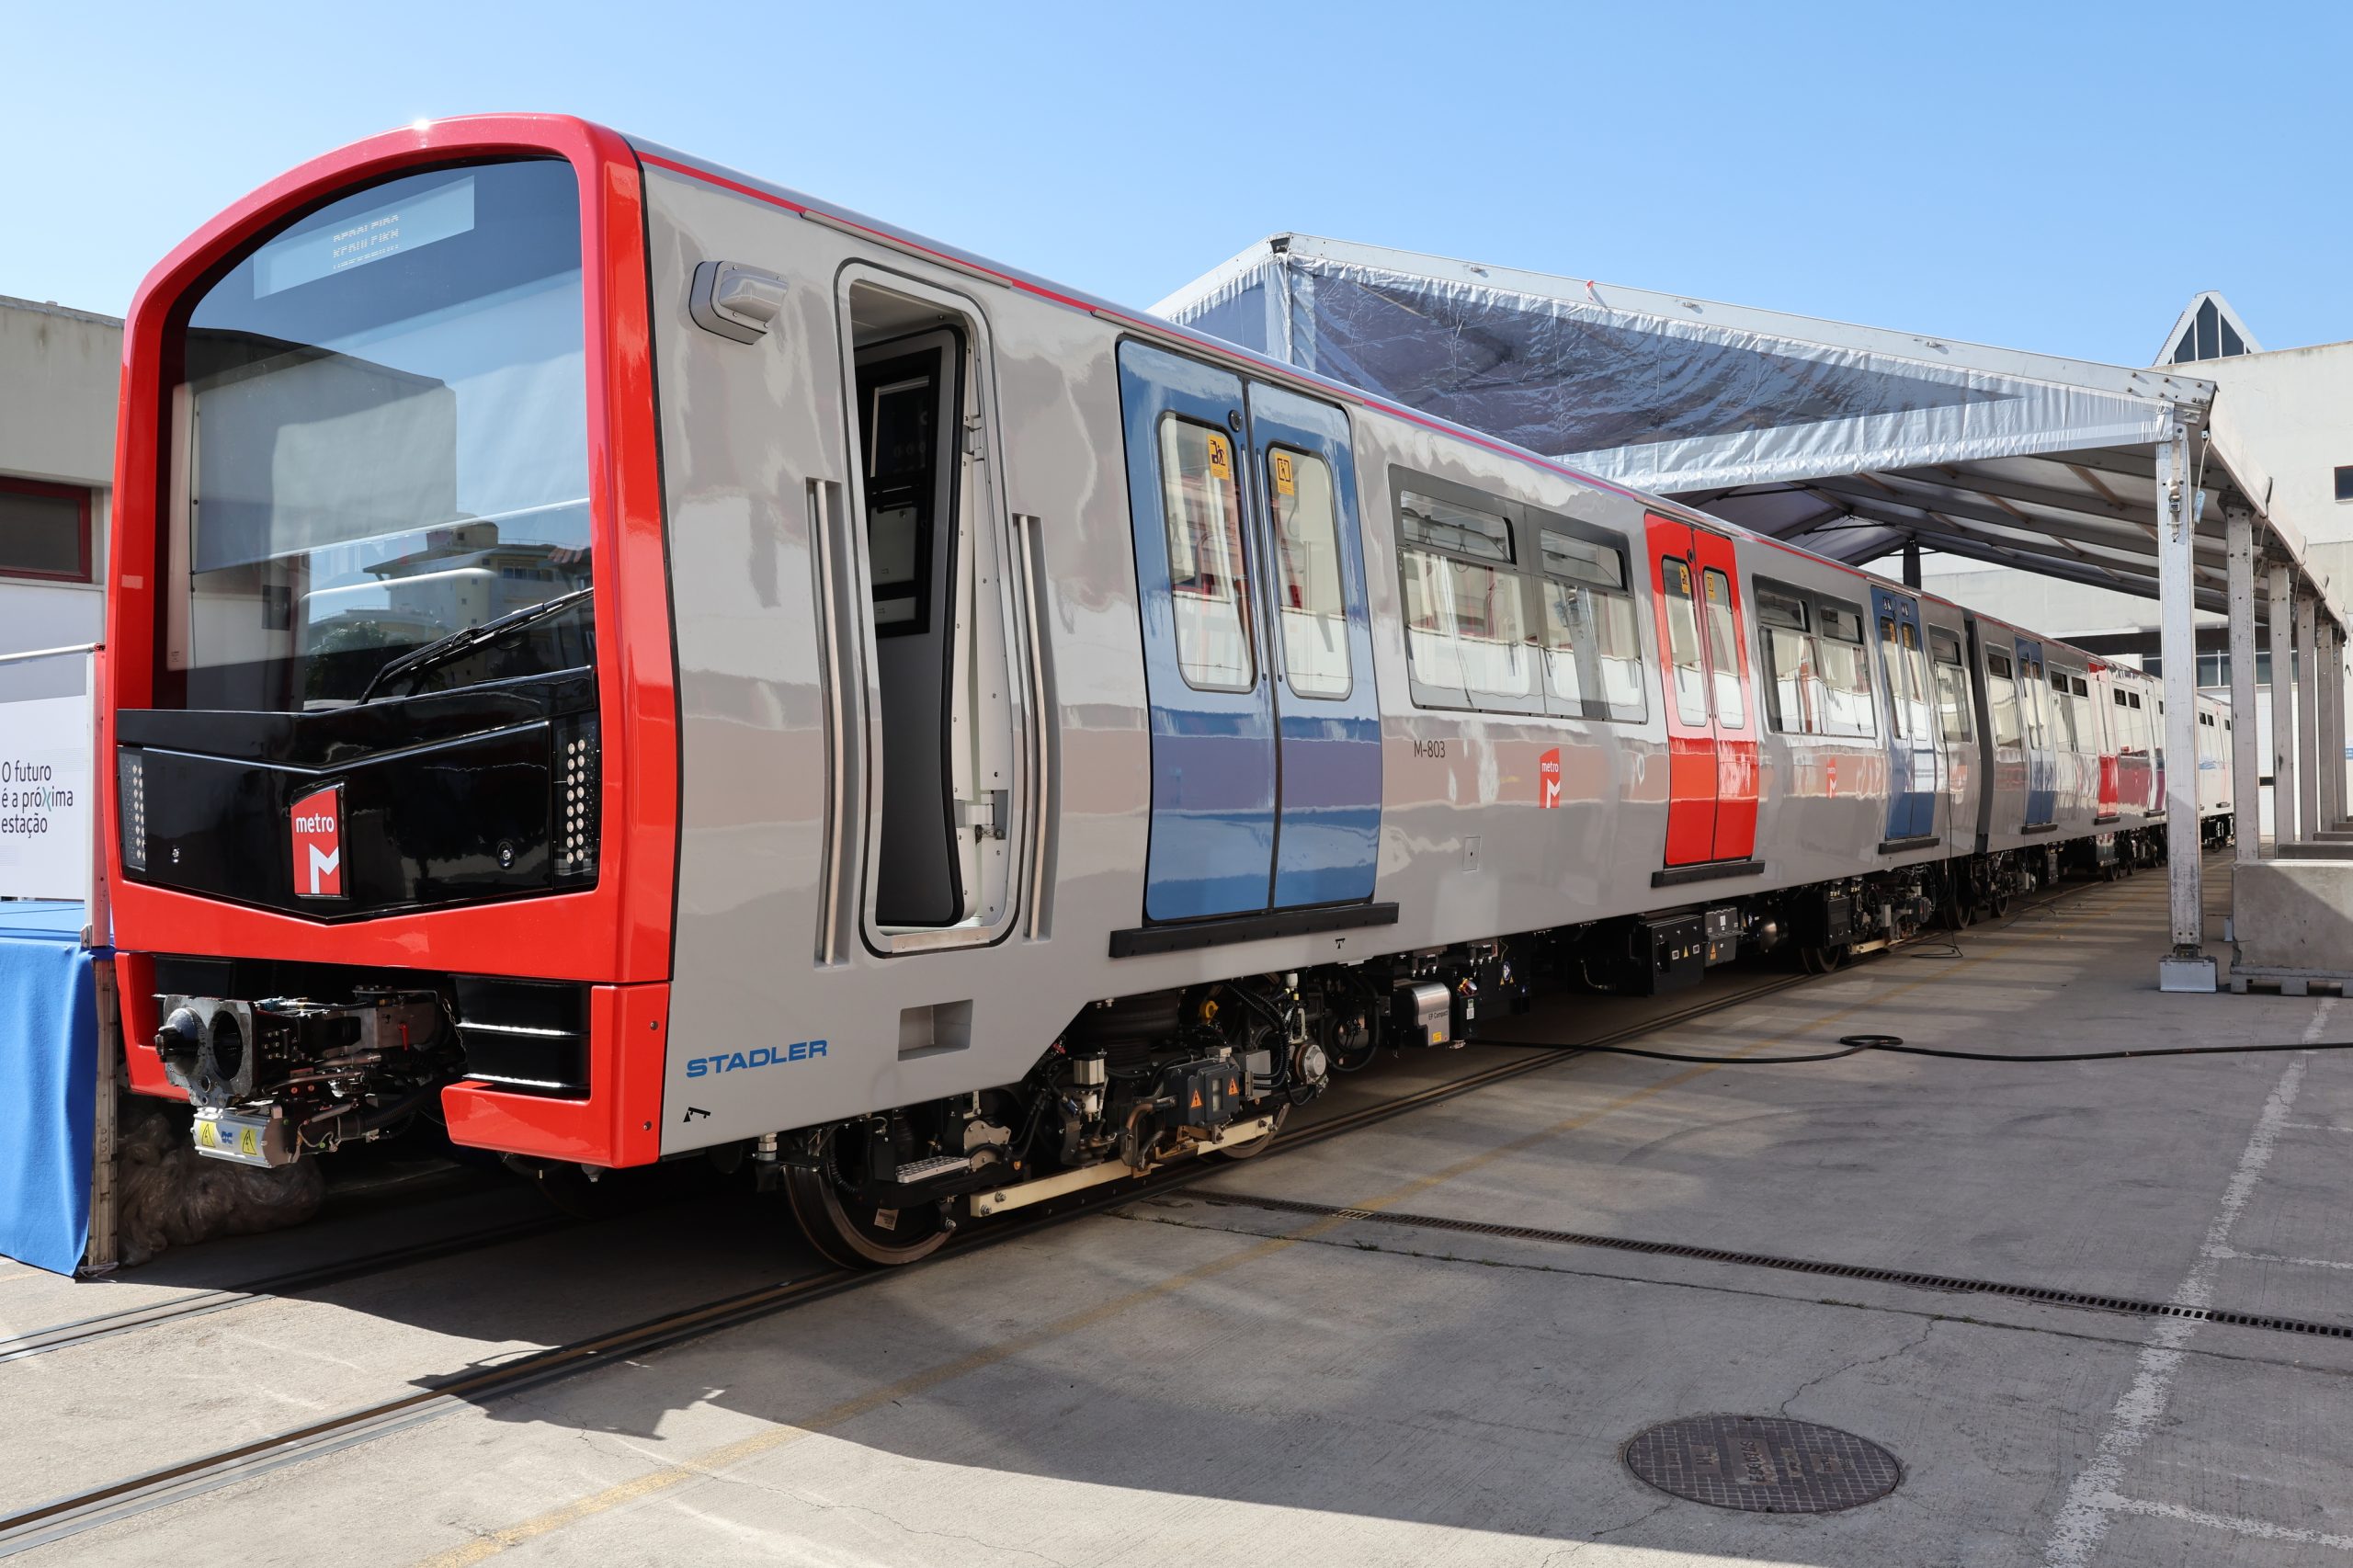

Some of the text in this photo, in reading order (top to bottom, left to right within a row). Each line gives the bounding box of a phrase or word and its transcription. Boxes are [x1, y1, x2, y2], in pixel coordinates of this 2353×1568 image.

[1414, 740, 1446, 758] M-803
[2, 759, 51, 783] O futuro
[1541, 760, 1559, 773] metro
[1, 785, 74, 814] é a próxima
[1, 812, 48, 839] estação
[295, 812, 335, 833] metro
[686, 1040, 827, 1078] STADLER
